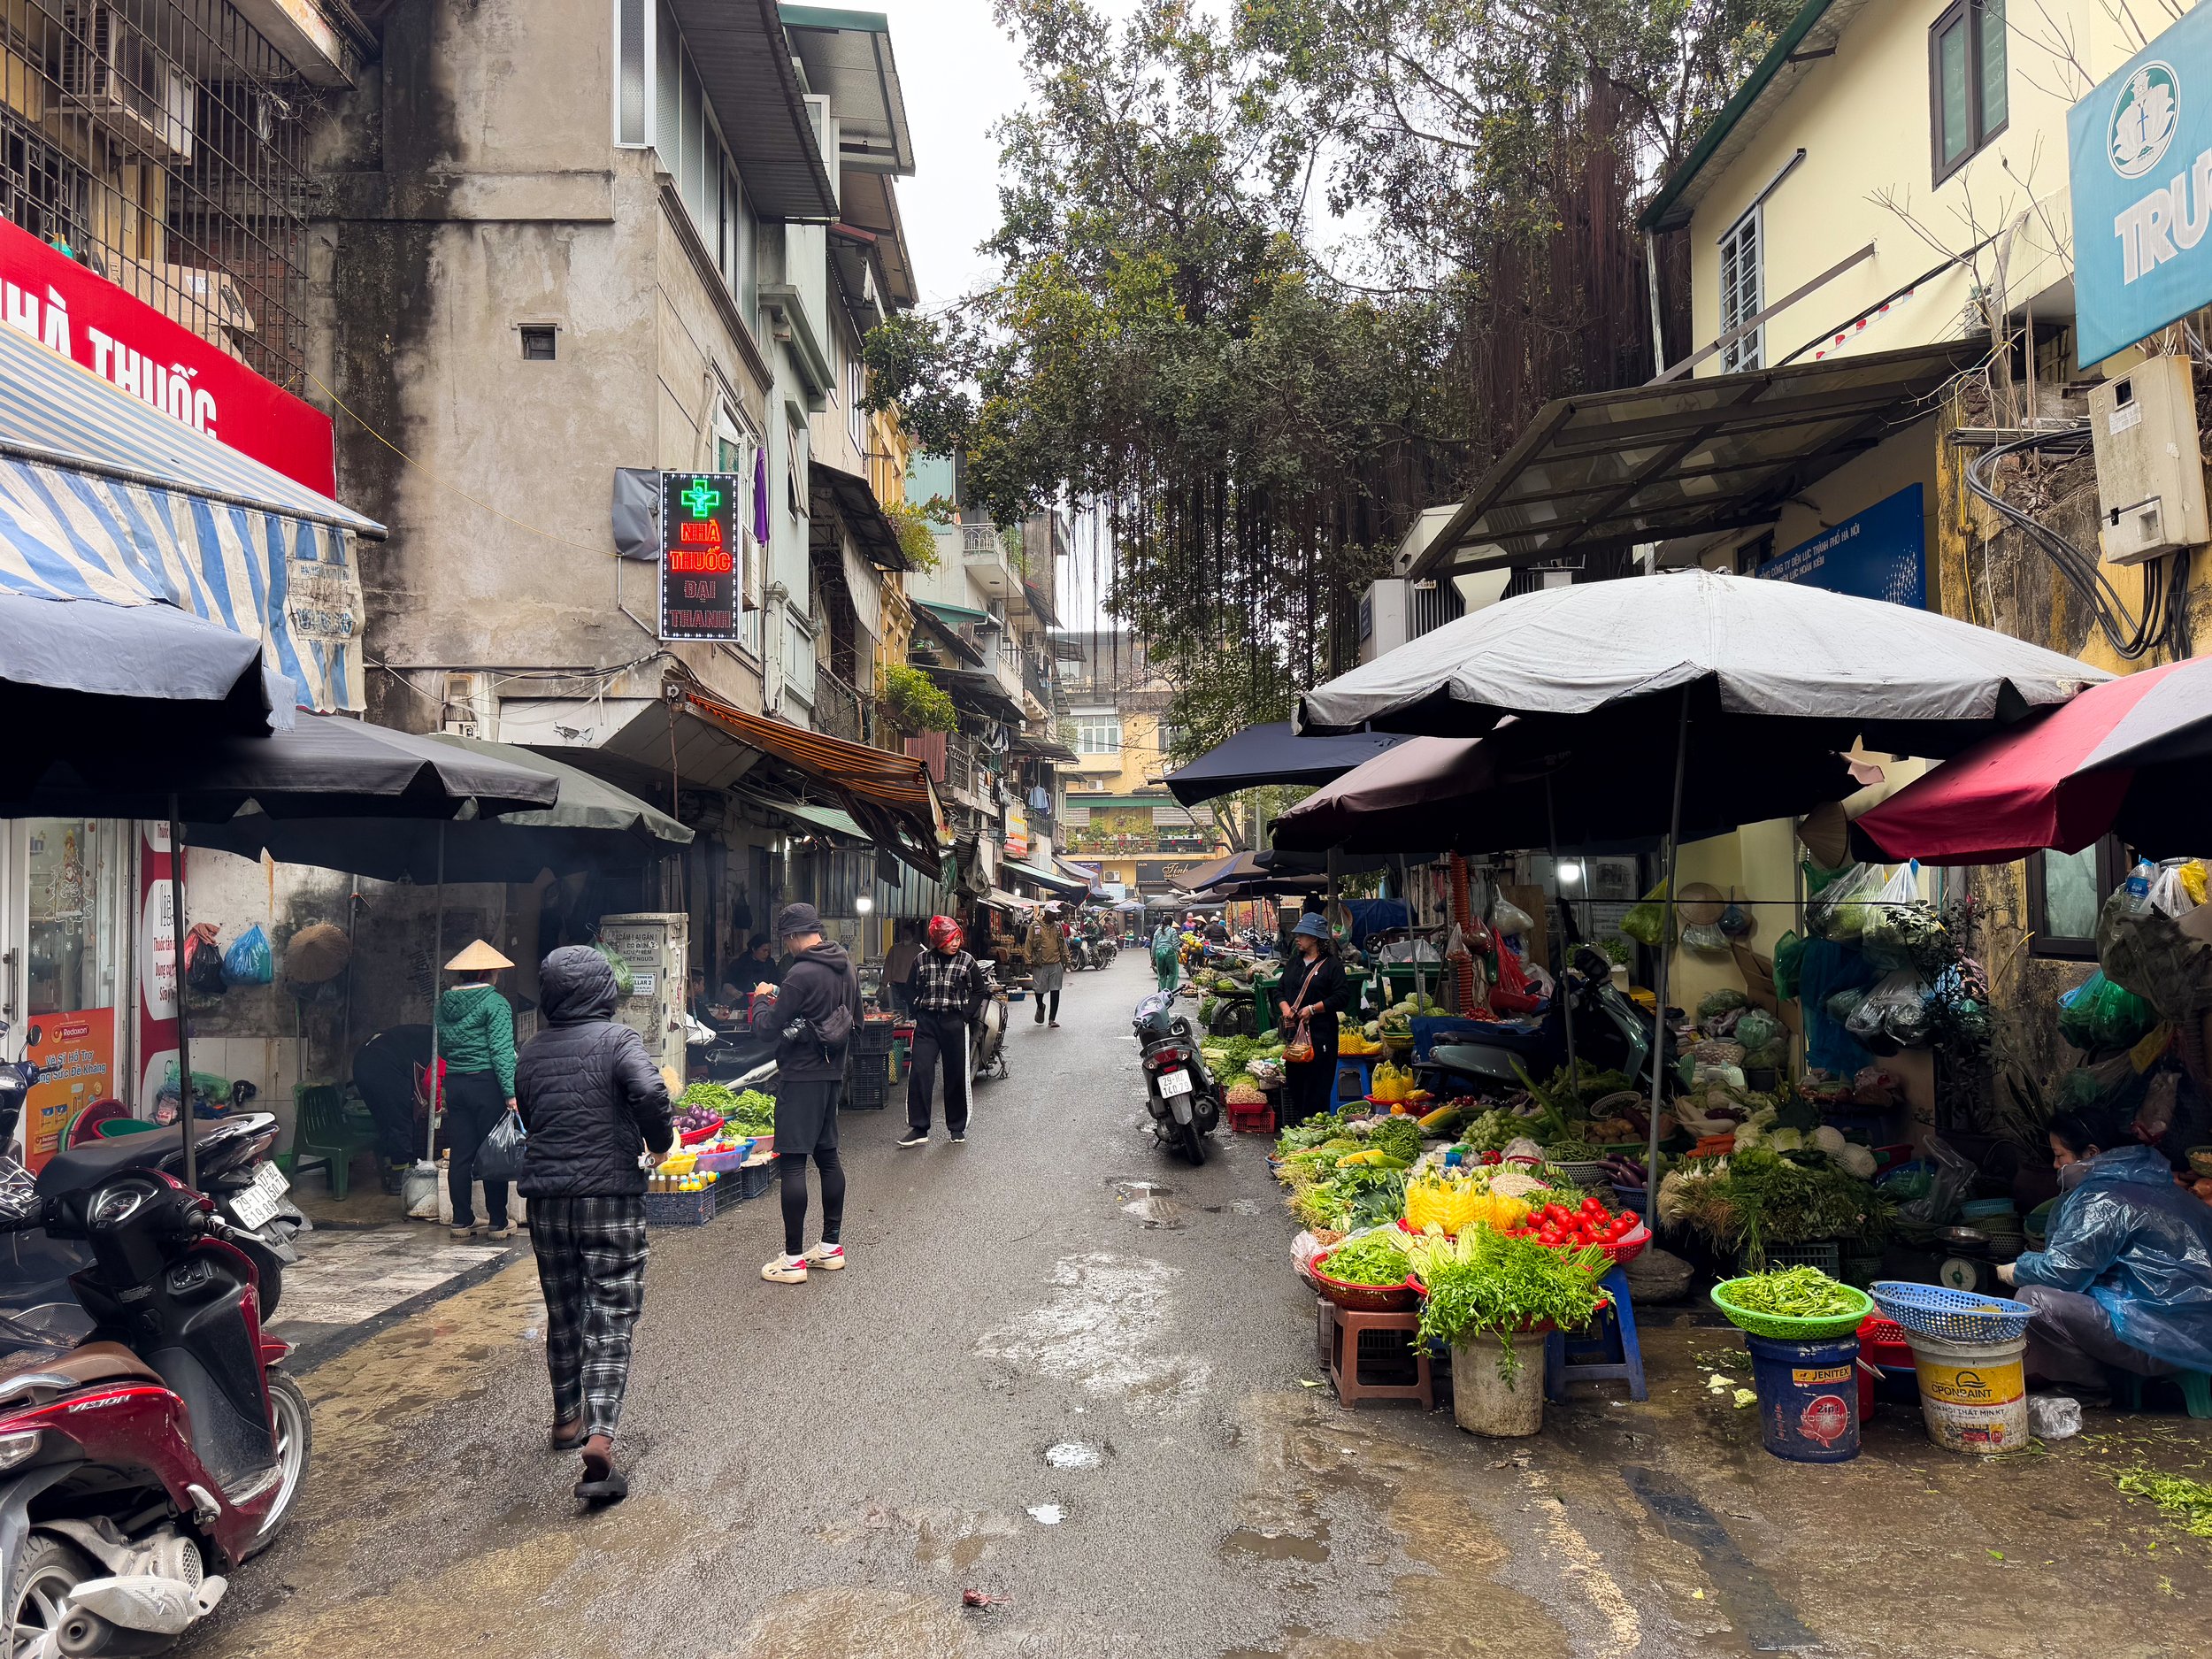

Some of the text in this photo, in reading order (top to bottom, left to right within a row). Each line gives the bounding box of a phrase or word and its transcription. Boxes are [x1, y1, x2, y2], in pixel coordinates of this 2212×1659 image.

[0, 277, 217, 440] HÀ THUỐC
[680, 519, 721, 542] NHÀ
[1784, 559, 1791, 571] TY
[1792, 553, 1801, 567] ĐIỆN
[1813, 541, 1829, 557] THÀNH
[1830, 529, 1840, 549] PHỐ
[1841, 528, 1849, 542] HÀ
[1850, 522, 1861, 537] NỘI
[669, 546, 732, 571] THUỐC
[684, 580, 716, 603] ĐẠI
[669, 609, 731, 628] THANH
[81, 1049, 94, 1062] Trợ
[83, 1062, 106, 1074] Kháng
[1163, 1081, 1190, 1096] 140.79
[235, 1188, 265, 1212] 29-Y1
[243, 1200, 278, 1226] 519.88
[1813, 1367, 1849, 1381] JENITEX
[68, 1394, 132, 1413] VISION
